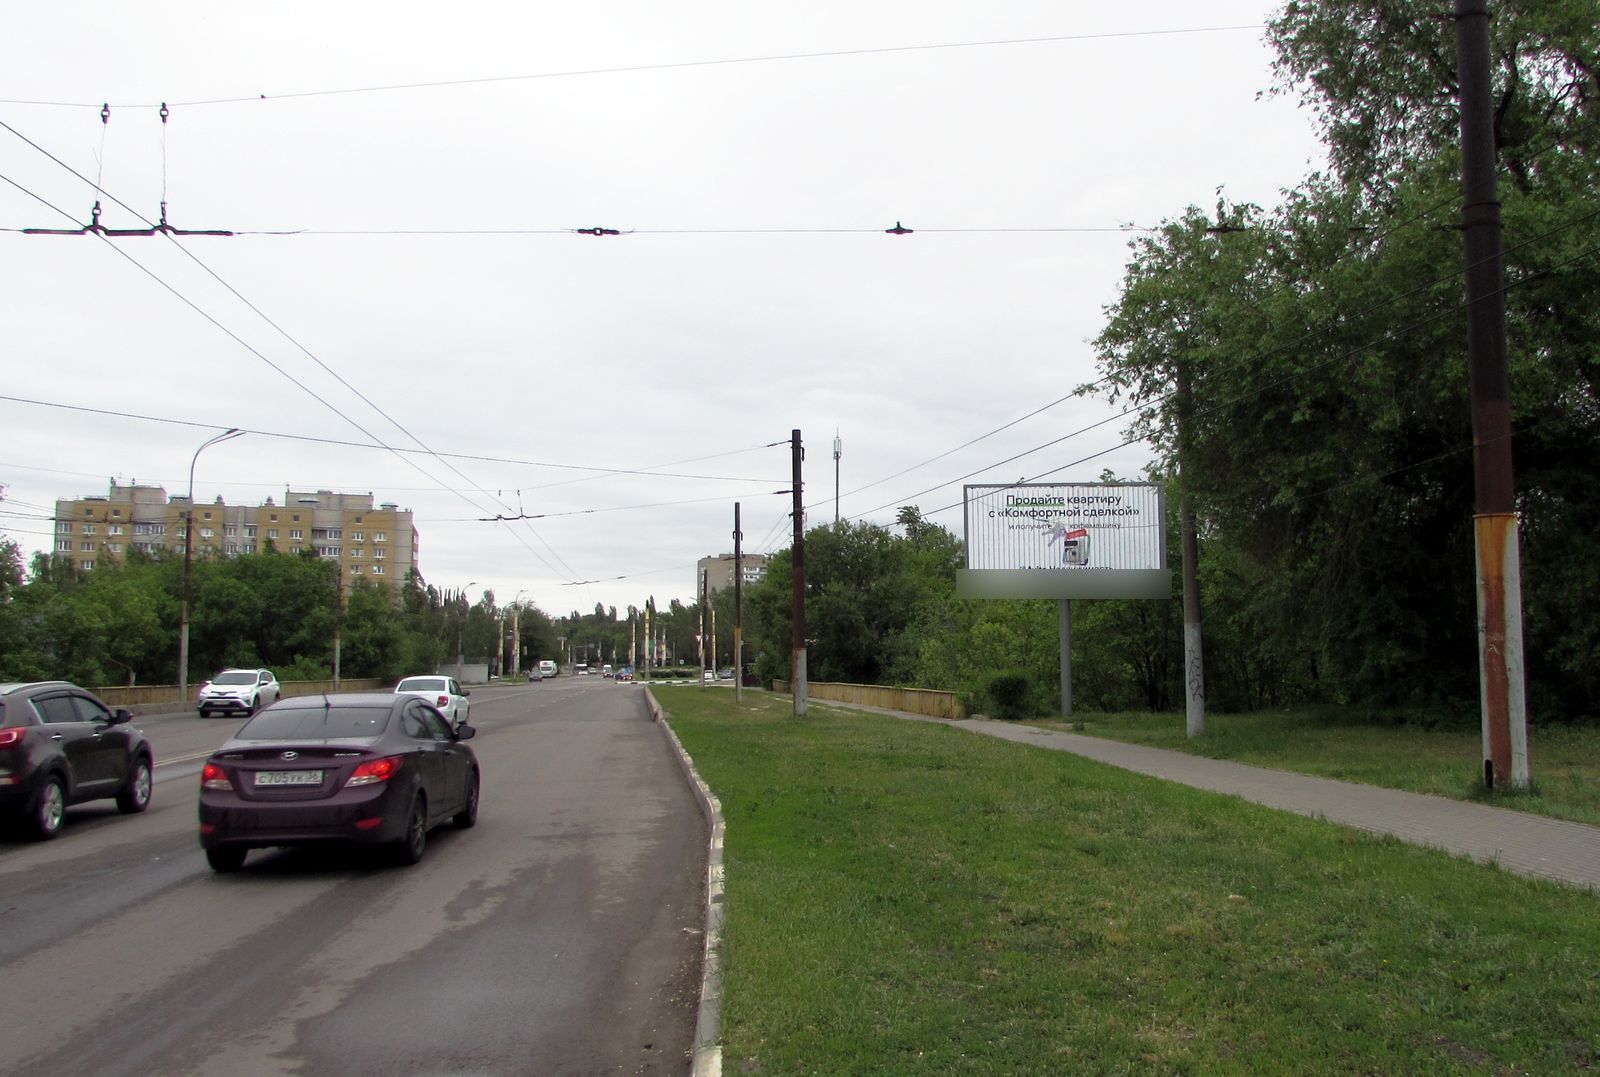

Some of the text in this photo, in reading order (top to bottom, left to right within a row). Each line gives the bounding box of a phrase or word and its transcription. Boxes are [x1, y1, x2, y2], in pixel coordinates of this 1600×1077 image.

[1006, 494, 1121, 507] Продайте квартиру
[988, 506, 1139, 519] с «Комфортной сделкой»
